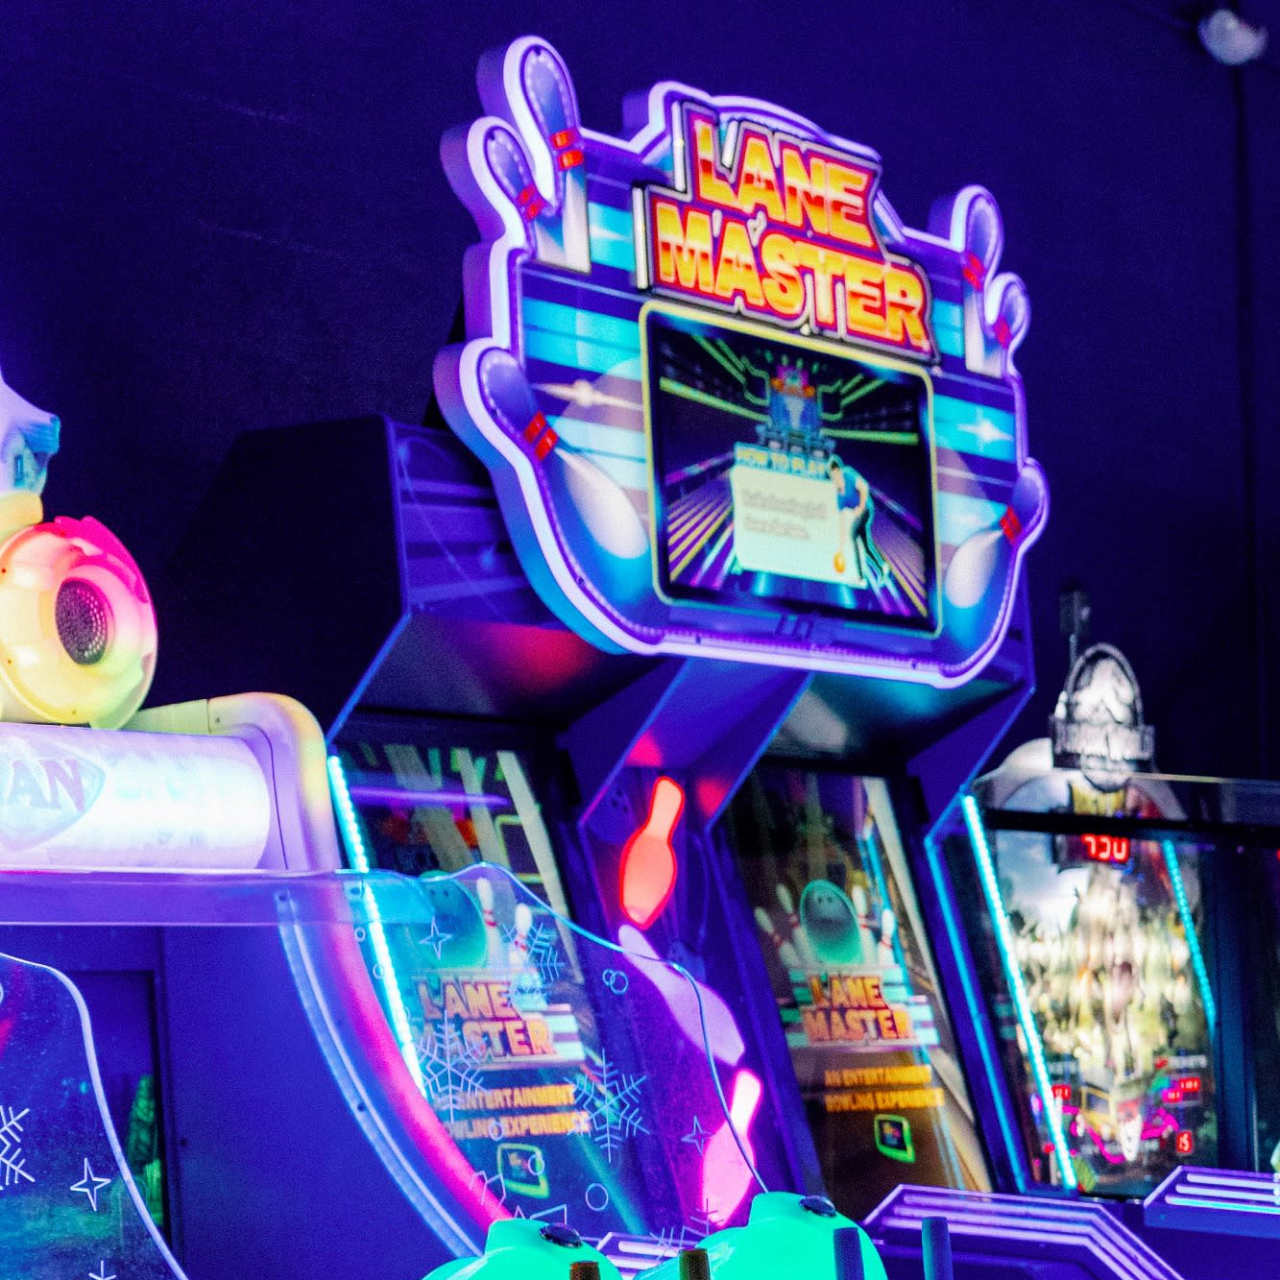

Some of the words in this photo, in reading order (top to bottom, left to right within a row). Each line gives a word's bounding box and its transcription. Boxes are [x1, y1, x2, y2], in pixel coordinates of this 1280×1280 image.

[692, 118, 877, 250] LANE
[655, 201, 931, 352] MASTER
[417, 981, 521, 1019] LANE
[809, 974, 889, 1008] LANE
[802, 1009, 912, 1041] MASTER
